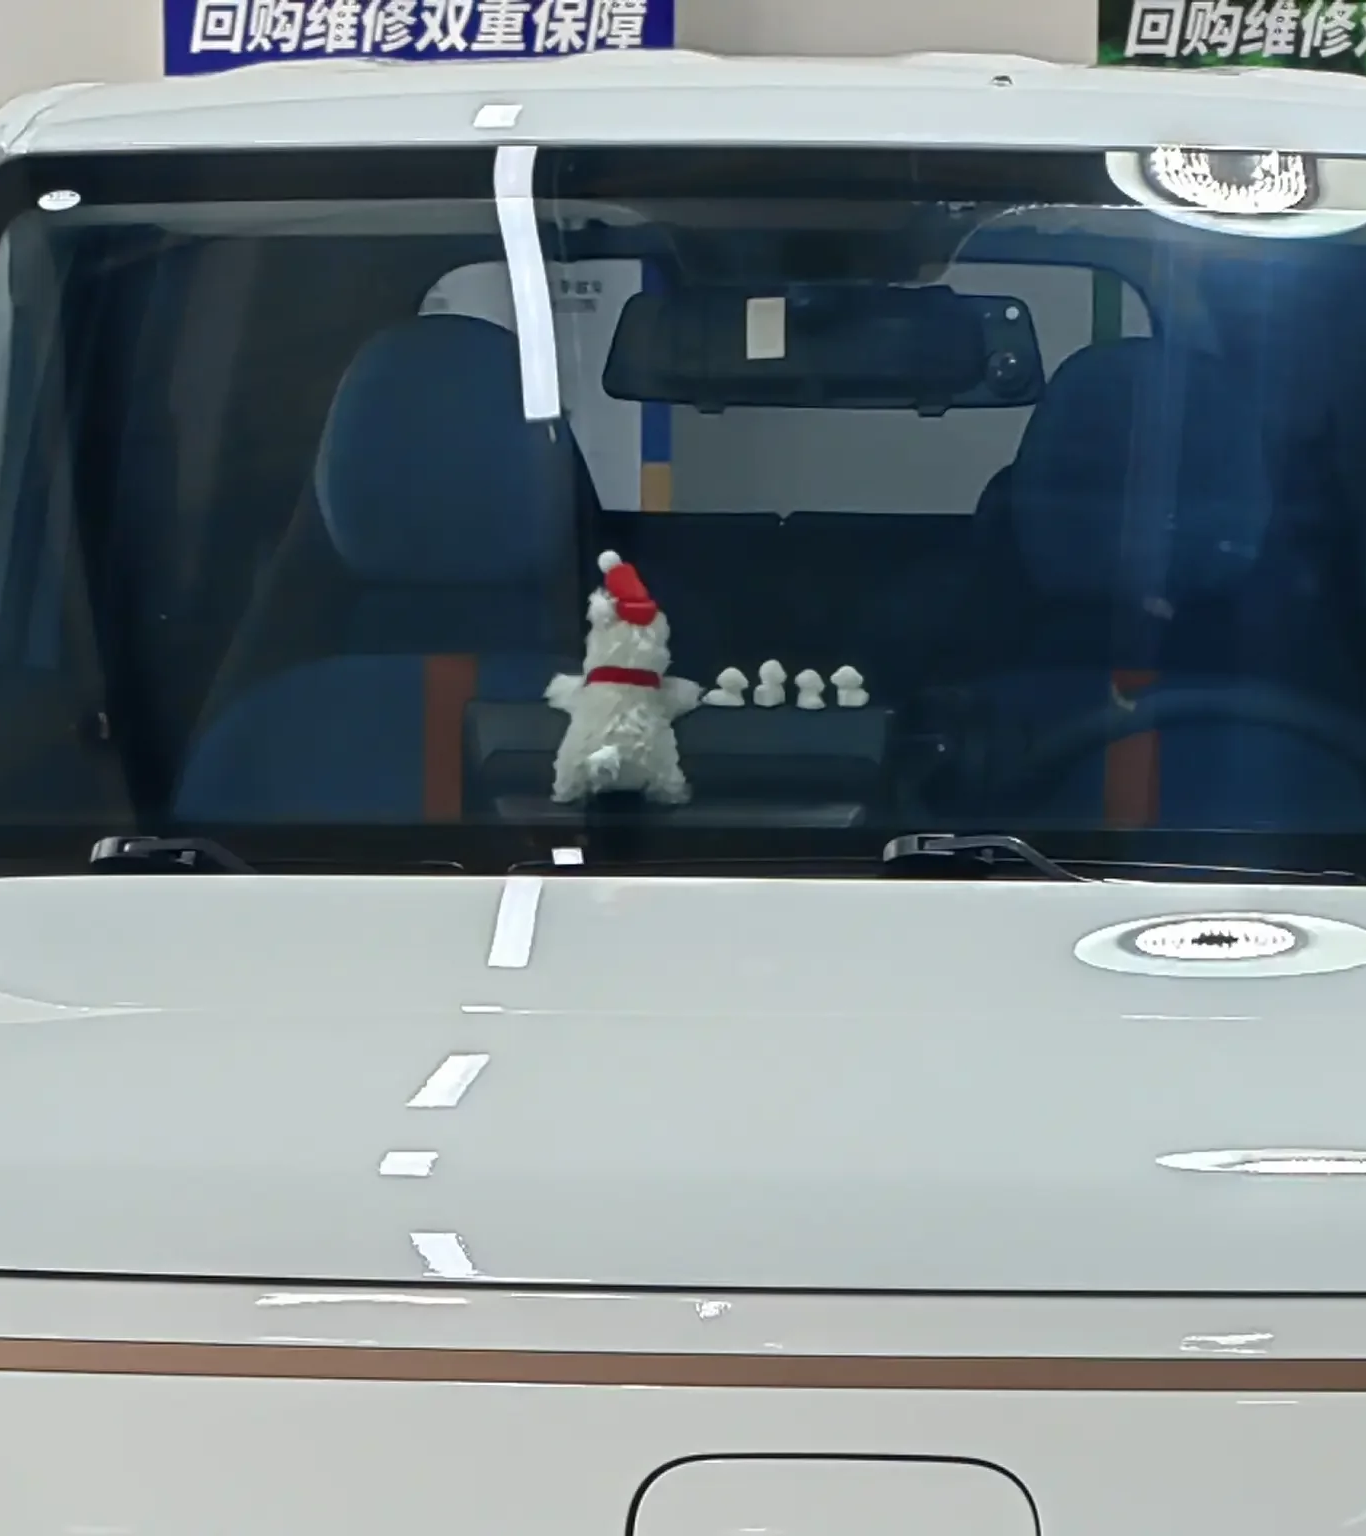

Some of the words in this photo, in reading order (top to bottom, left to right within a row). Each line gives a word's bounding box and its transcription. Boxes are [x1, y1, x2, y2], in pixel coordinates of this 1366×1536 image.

[189, 0, 647, 54] 回购维修双重保障
